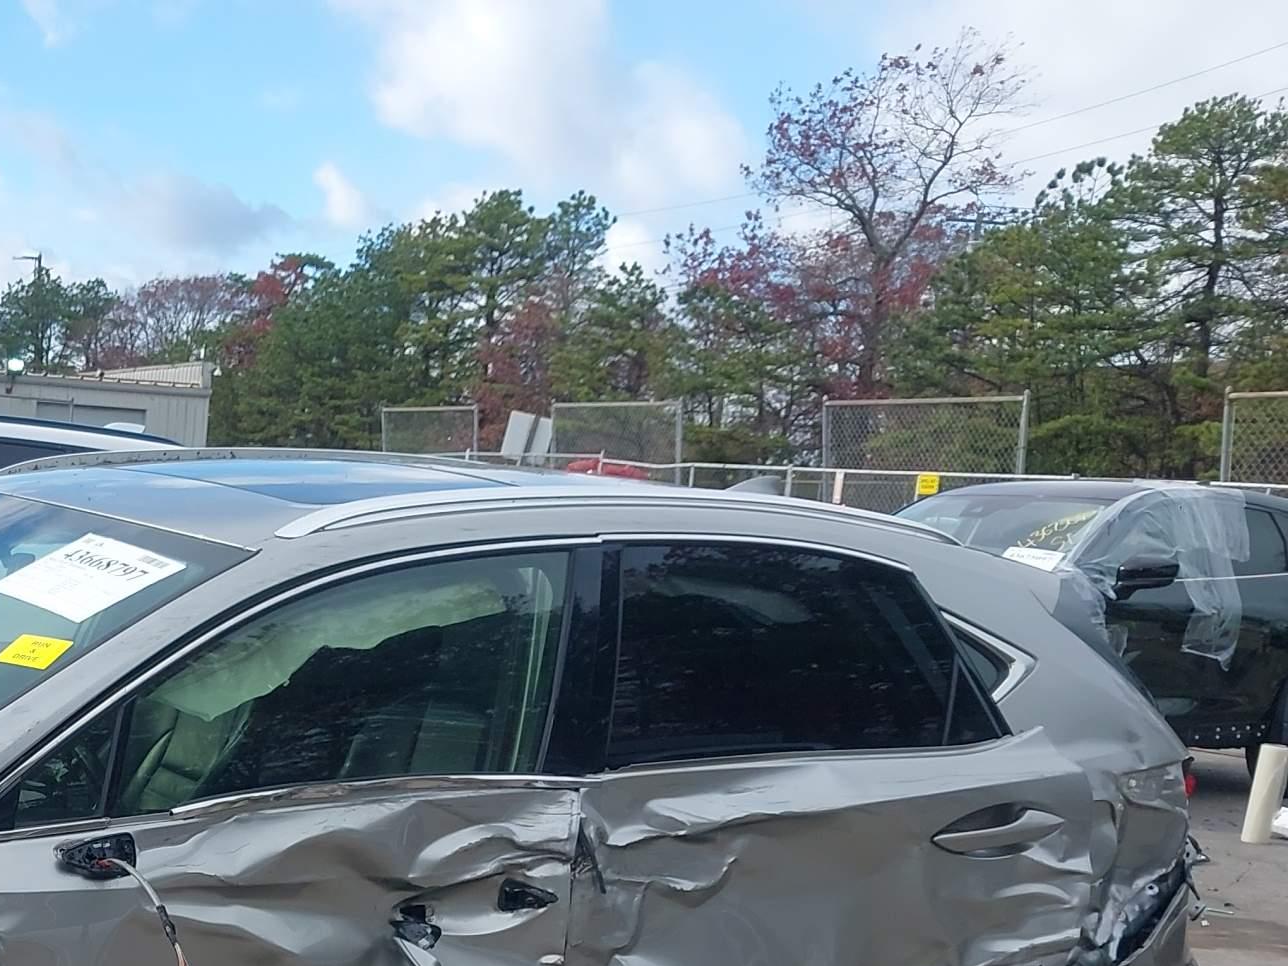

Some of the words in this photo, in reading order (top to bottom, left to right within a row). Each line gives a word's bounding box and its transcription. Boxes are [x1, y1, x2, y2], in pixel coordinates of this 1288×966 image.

[63, 548, 149, 582] 43668797
[31, 640, 52, 649] RUN
[11, 653, 40, 662] DRIVE
